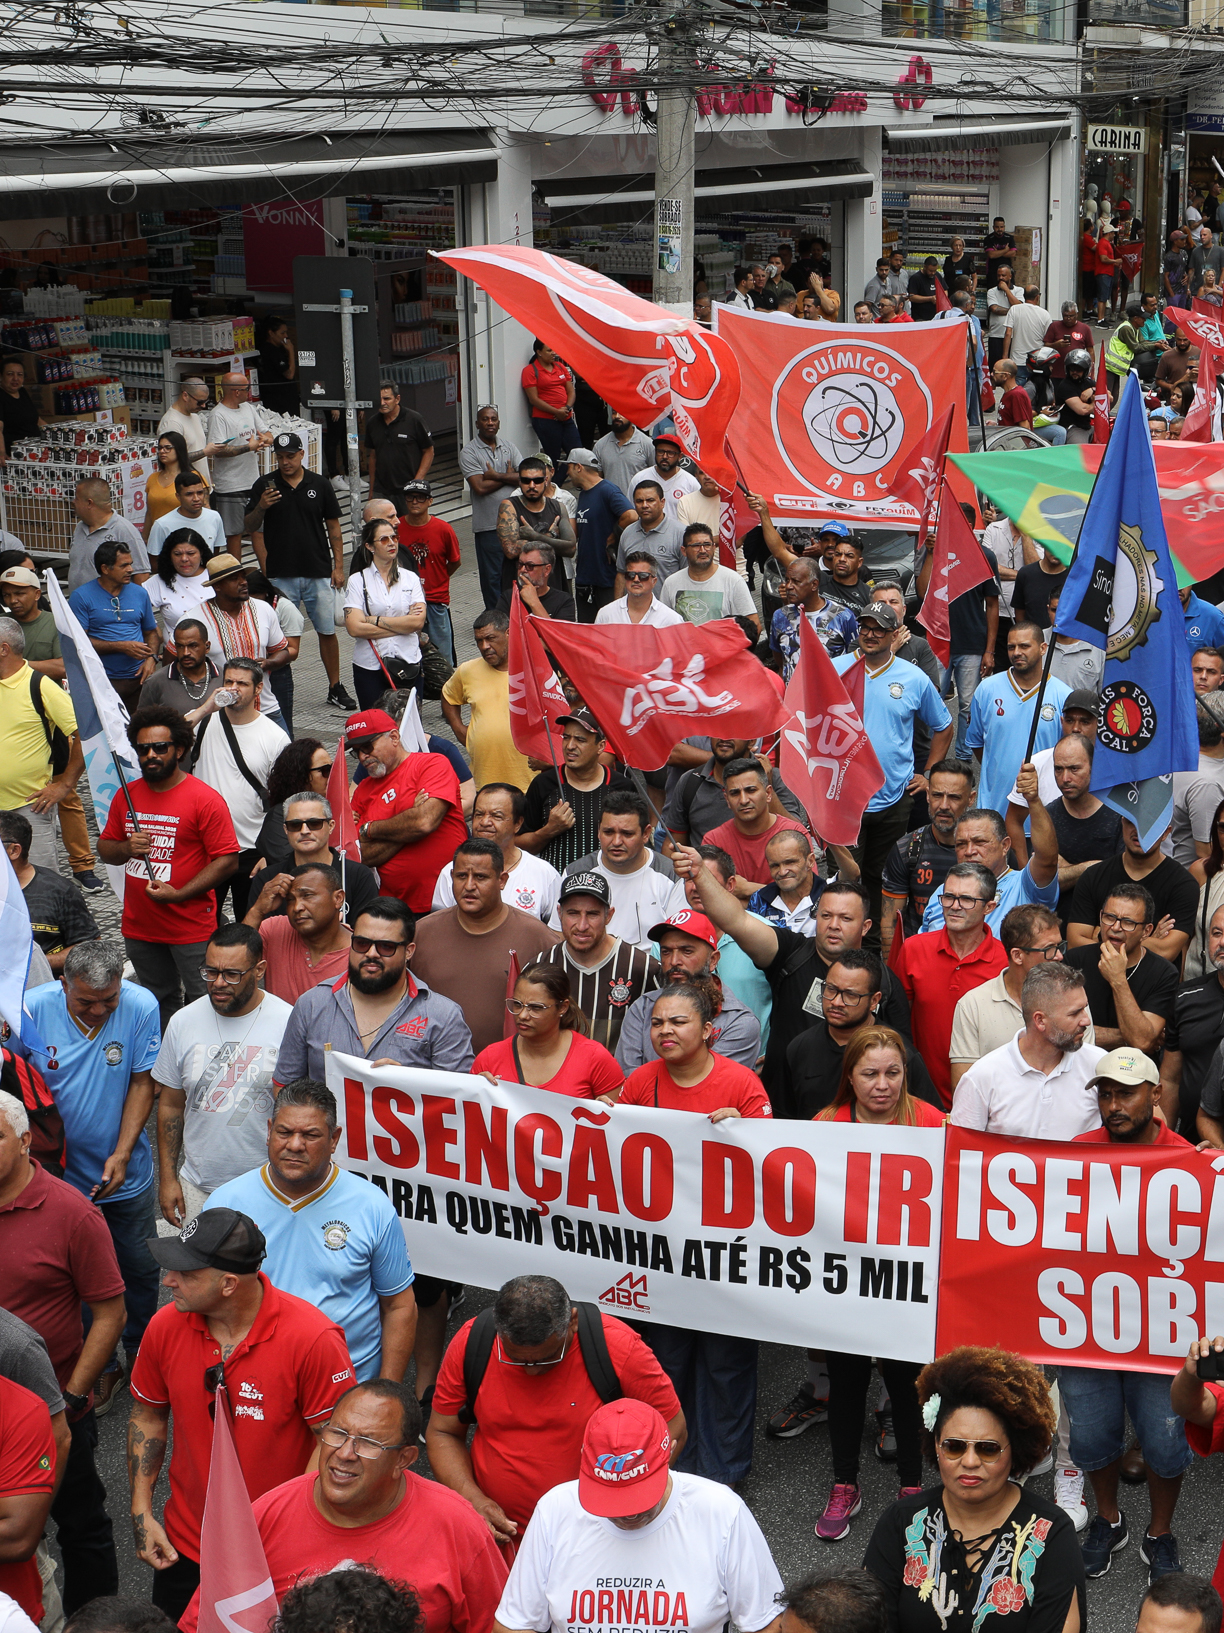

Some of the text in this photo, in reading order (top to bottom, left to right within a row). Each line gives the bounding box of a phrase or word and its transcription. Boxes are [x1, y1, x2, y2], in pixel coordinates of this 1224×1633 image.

[1092, 127, 1141, 151] CARINA
[802, 349, 902, 388] QUÍMICOS
[1131, 686, 1154, 739] FORÇA
[381, 788, 397, 804] 13
[917, 868, 933, 885] 39
[344, 1077, 933, 1248] ISENÇÃO DO IR
[348, 1170, 930, 1303] ARA QUEM GANHA ATÉ R$ 5 MIL
[598, 1286, 651, 1310] ABC
[596, 1577, 666, 1589] REDUZIR A
[567, 1589, 689, 1627] JORNADA
